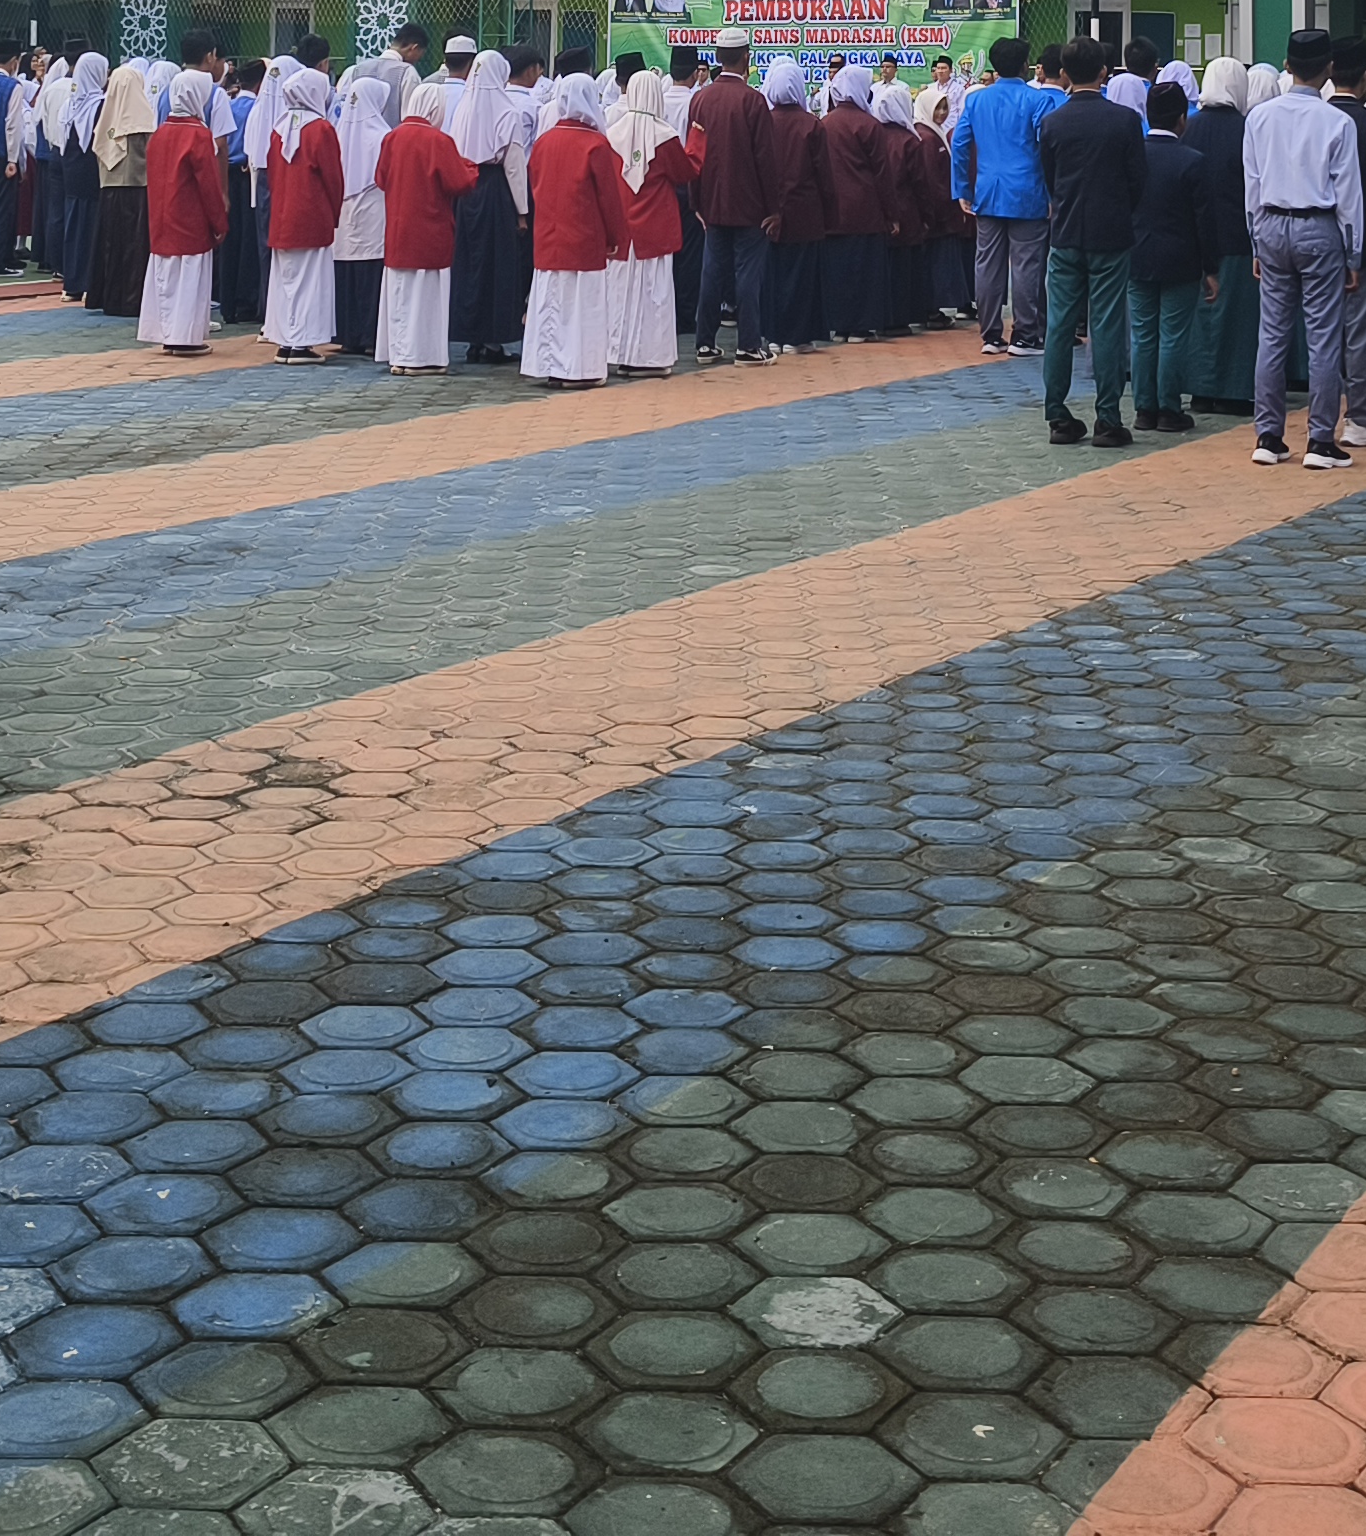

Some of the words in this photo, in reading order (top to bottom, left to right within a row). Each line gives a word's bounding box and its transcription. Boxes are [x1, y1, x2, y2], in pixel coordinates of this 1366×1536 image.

[753, 29, 800, 44] SAINS
[805, 27, 895, 44] MADRASAH
[900, 25, 950, 47] (KSM)
